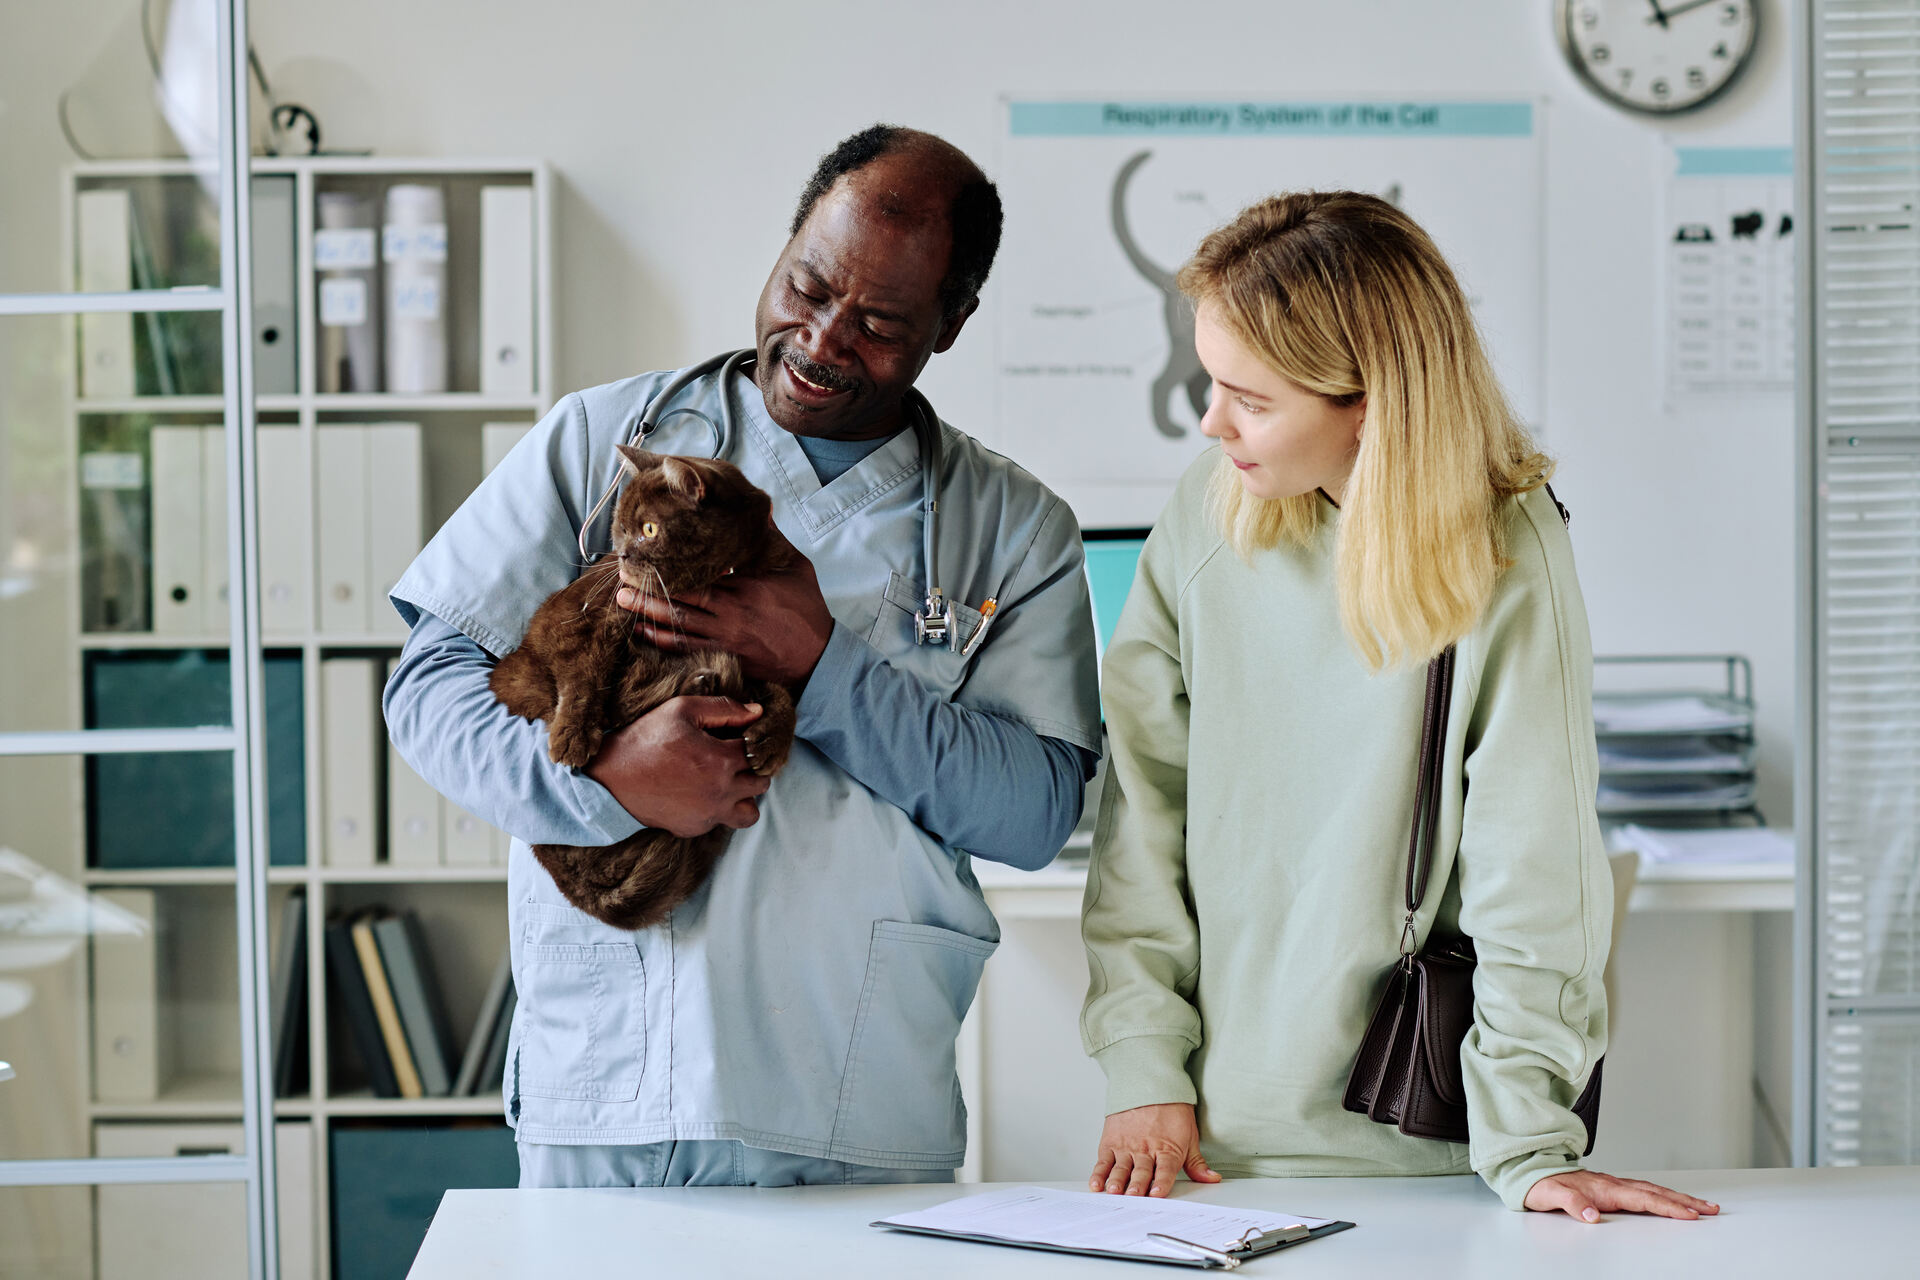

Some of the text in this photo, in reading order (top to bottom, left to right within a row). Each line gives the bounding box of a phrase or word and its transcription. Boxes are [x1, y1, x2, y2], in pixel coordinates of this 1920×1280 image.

[1652, 79, 1668, 98] 6
[1103, 103, 1439, 131] Respiratory System of the Cat
